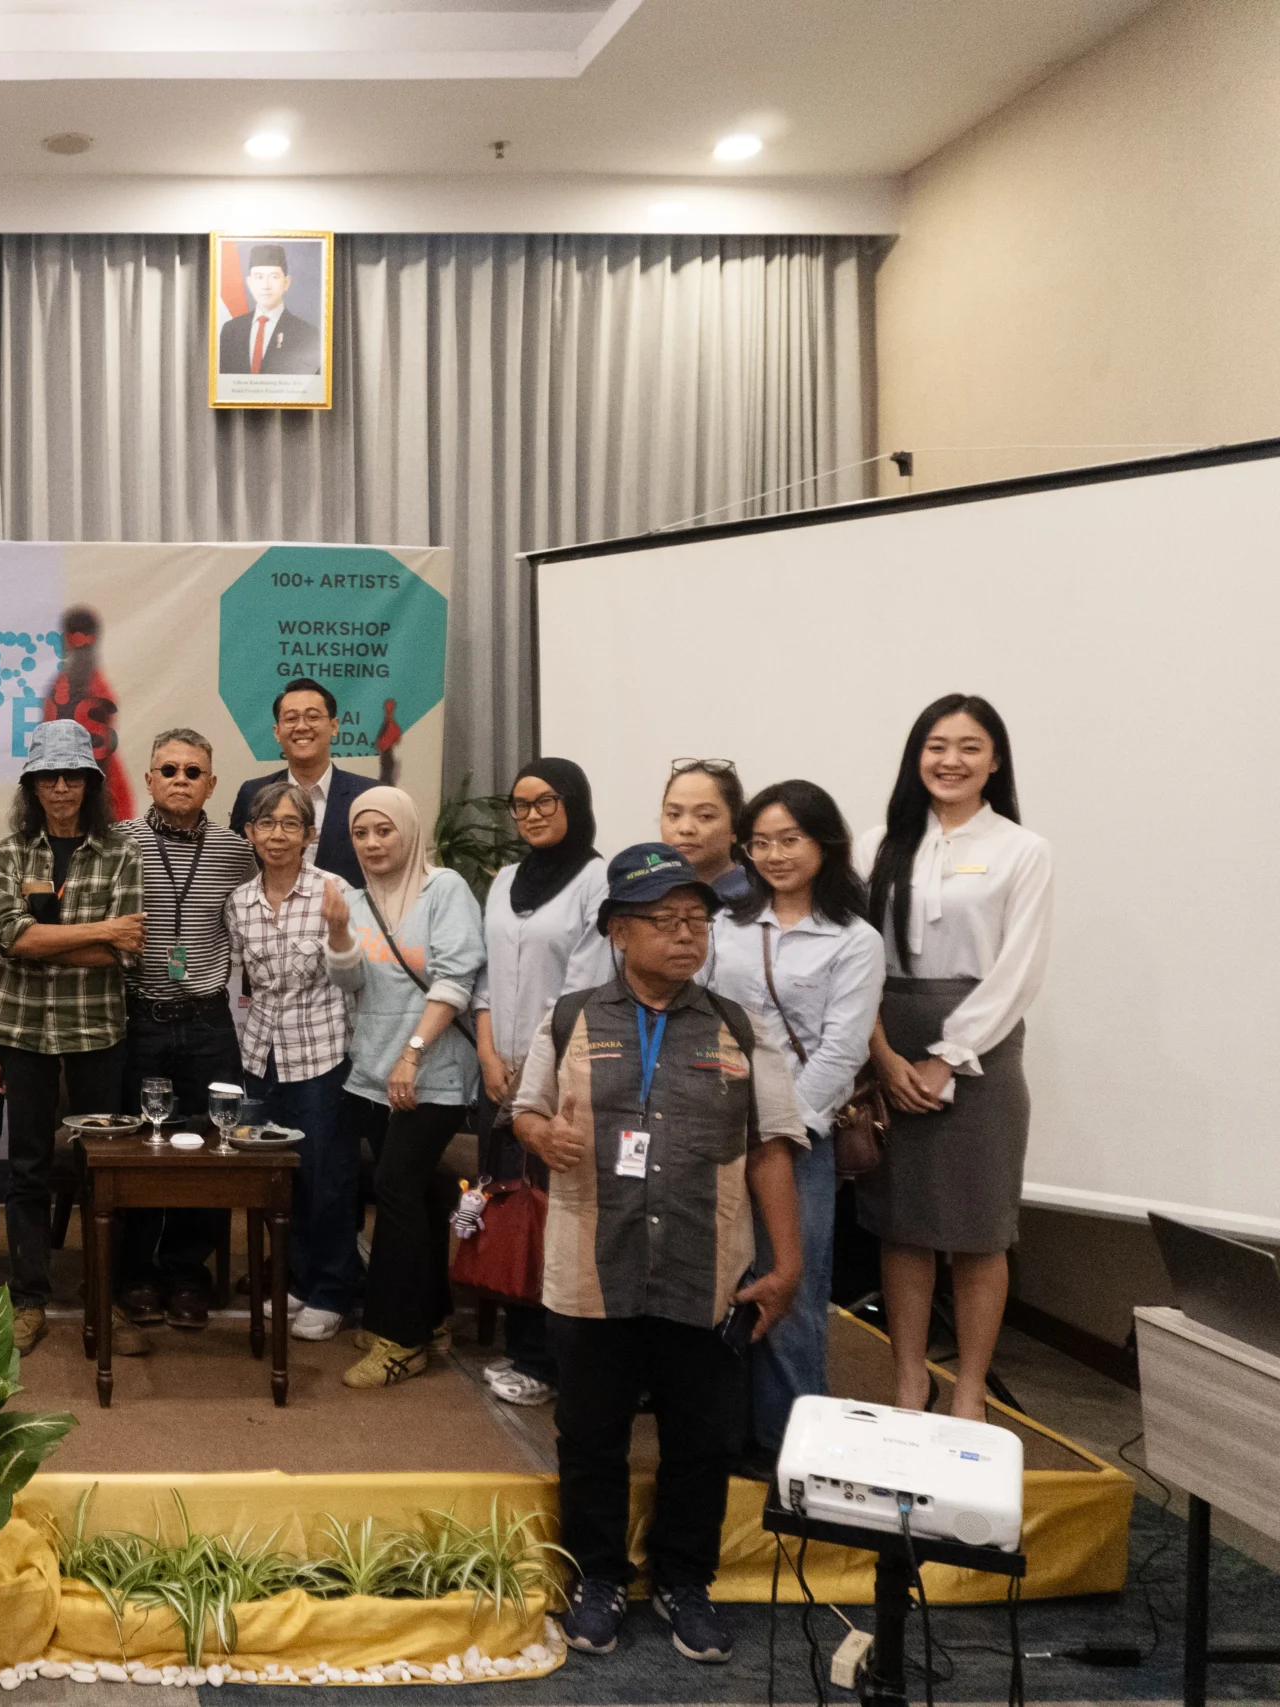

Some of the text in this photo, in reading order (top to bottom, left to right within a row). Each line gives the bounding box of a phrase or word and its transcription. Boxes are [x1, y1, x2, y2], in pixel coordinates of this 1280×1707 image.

[271, 573, 400, 589] 100+ ARTISTS
[278, 620, 391, 636] WORKSHOP
[279, 641, 388, 657] TALKSHOW
[277, 662, 390, 678] GATHERING
